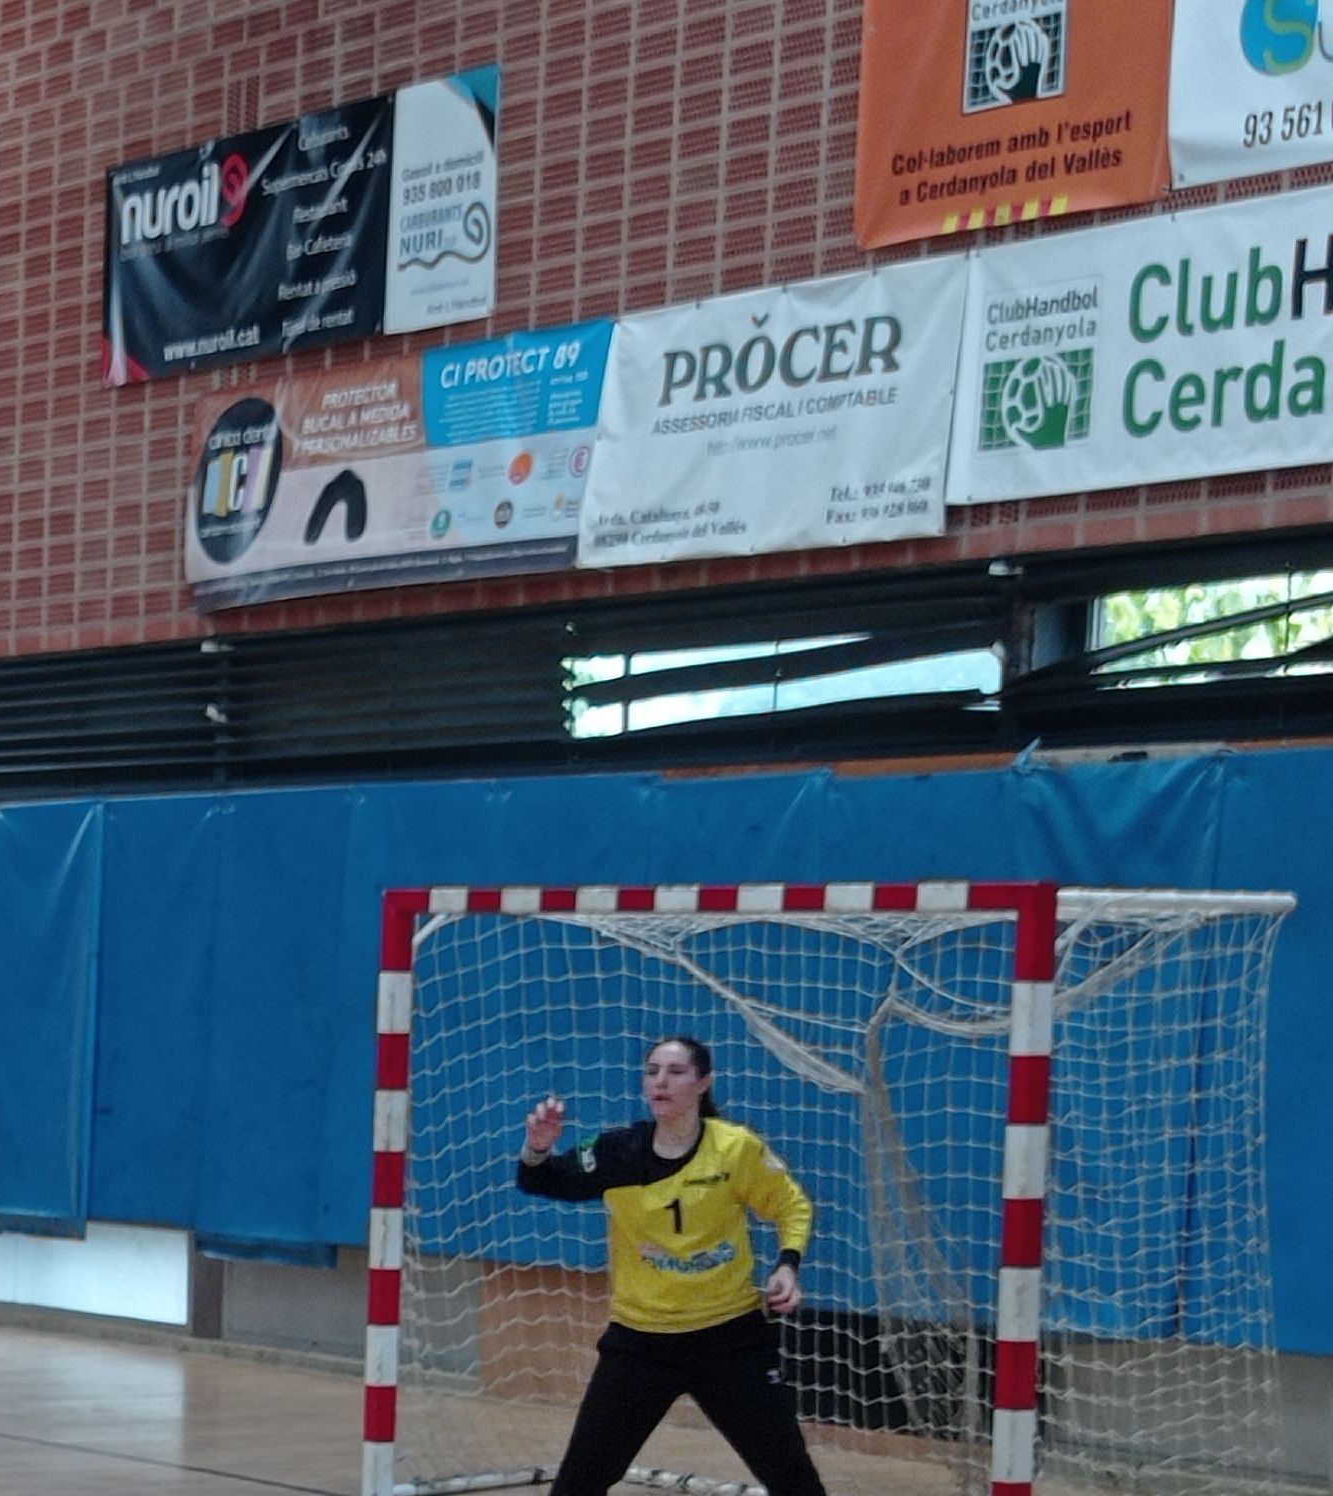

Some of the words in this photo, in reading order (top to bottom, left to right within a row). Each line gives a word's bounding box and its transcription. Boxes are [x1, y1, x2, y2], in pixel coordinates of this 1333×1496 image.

[1006, 126, 1050, 153] amb
[1057, 109, 1132, 144] l'esport
[1242, 111, 1274, 148] 93
[1281, 100, 1323, 141] 561
[899, 188, 911, 206] a
[916, 165, 1018, 204] Cerdanyola
[1024, 157, 1056, 182] del
[1063, 147, 1123, 176] Vallès
[121, 162, 220, 245] nuroil
[399, 228, 443, 257] NURI
[987, 284, 1098, 325] ClubHandbol
[985, 315, 1097, 353] Cerdanyola
[440, 361, 461, 389] CI
[464, 345, 551, 385] PROTECT
[553, 339, 581, 370] 89
[322, 378, 399, 410] PROTECTOR
[740, 402, 795, 424] FISCAL
[805, 387, 899, 418] COMPTABLE
[302, 409, 346, 435] BUCAL
[664, 1197, 684, 1235] 1
